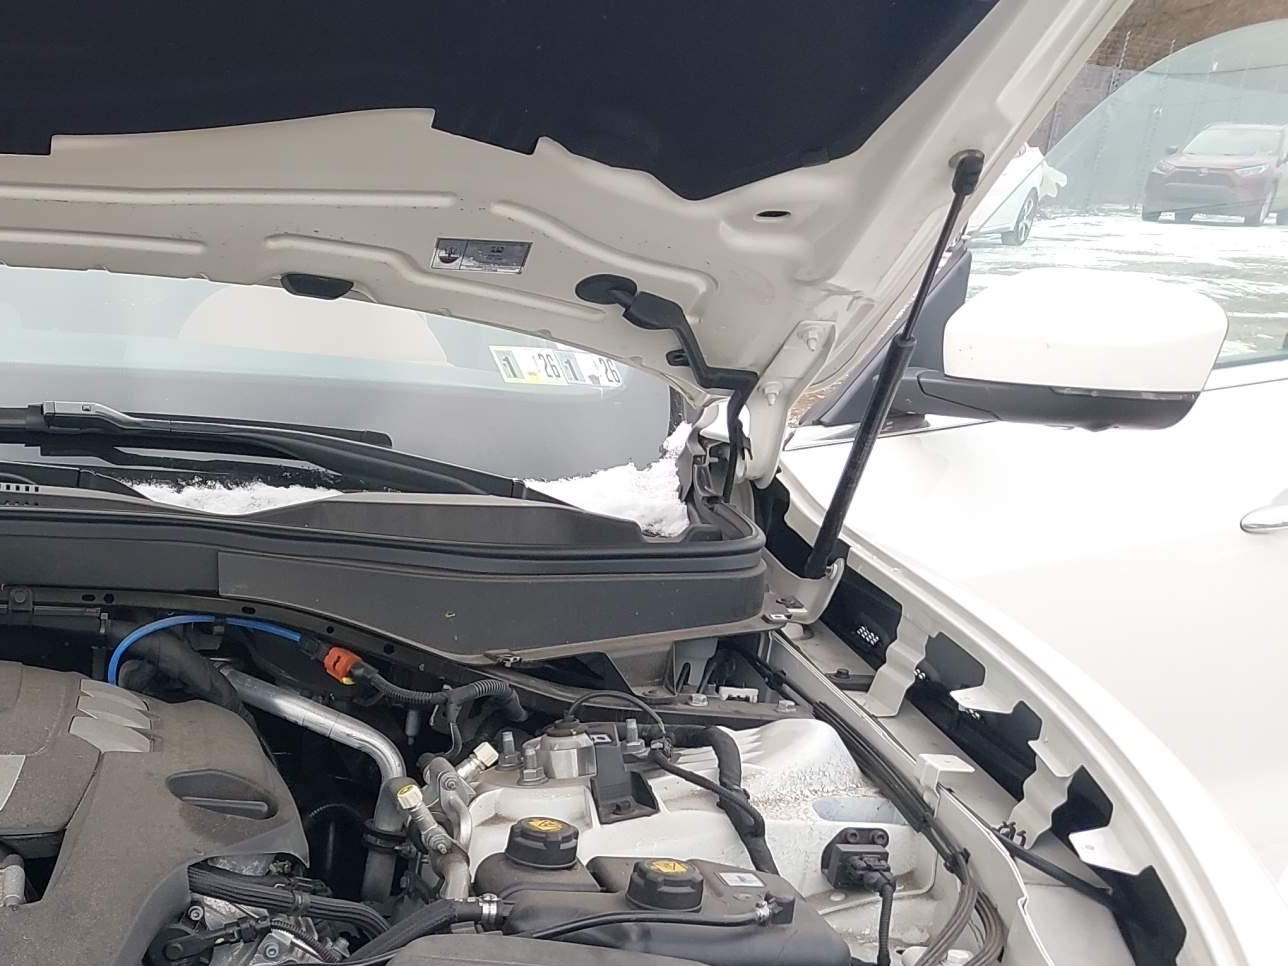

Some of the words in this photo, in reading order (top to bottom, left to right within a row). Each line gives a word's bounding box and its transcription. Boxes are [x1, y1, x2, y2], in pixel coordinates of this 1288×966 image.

[502, 356, 518, 378] 1
[538, 353, 561, 378] 26
[564, 359, 579, 381] 1
[598, 358, 621, 383] 26
